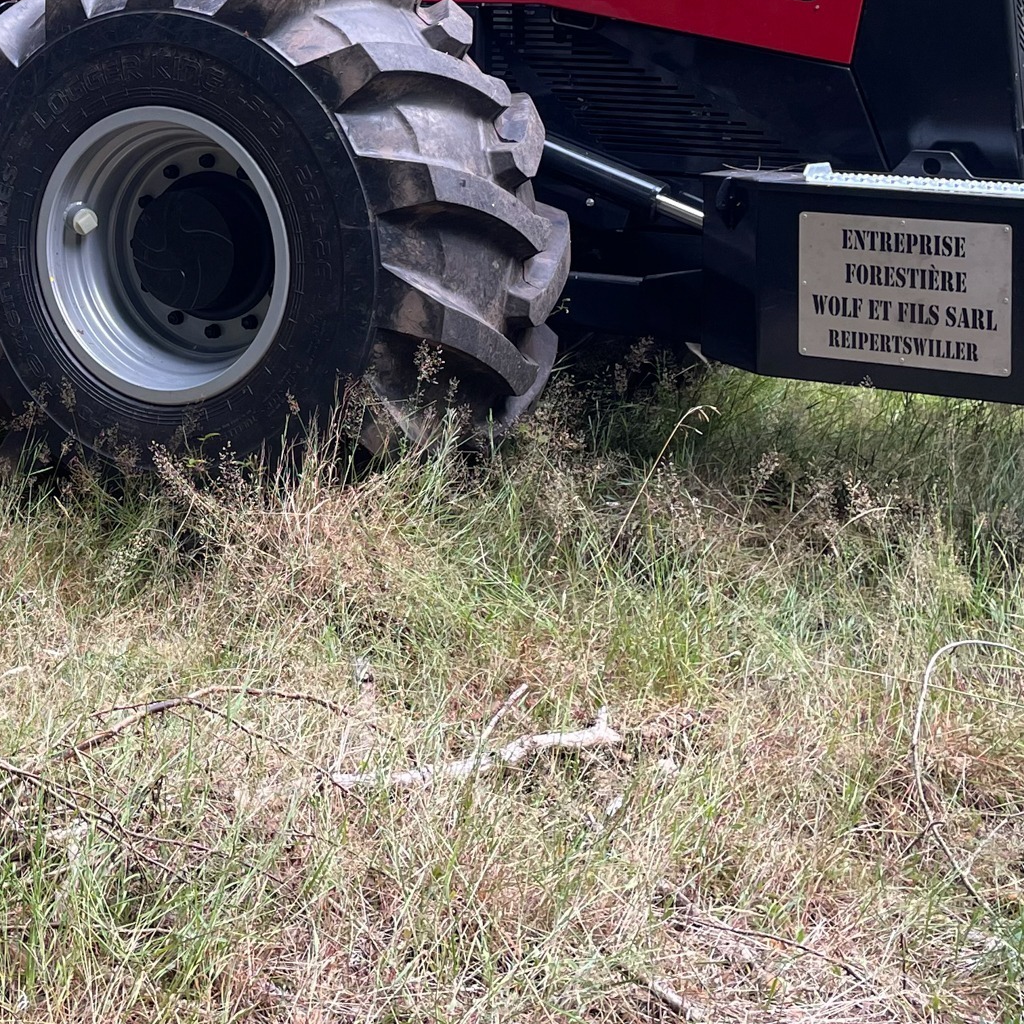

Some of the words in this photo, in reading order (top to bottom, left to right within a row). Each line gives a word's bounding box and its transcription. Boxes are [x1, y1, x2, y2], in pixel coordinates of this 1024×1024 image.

[32, 53, 144, 130] LOGGER
[842, 228, 966, 258] ENTREPRISE
[845, 263, 967, 293] FORESTIÈRE
[812, 294, 863, 318] WOLF
[868, 299, 892, 321] ET
[897, 301, 939, 326] FILS
[945, 306, 998, 331] SARL
[828, 329, 979, 362] REIPERTSWILLER
